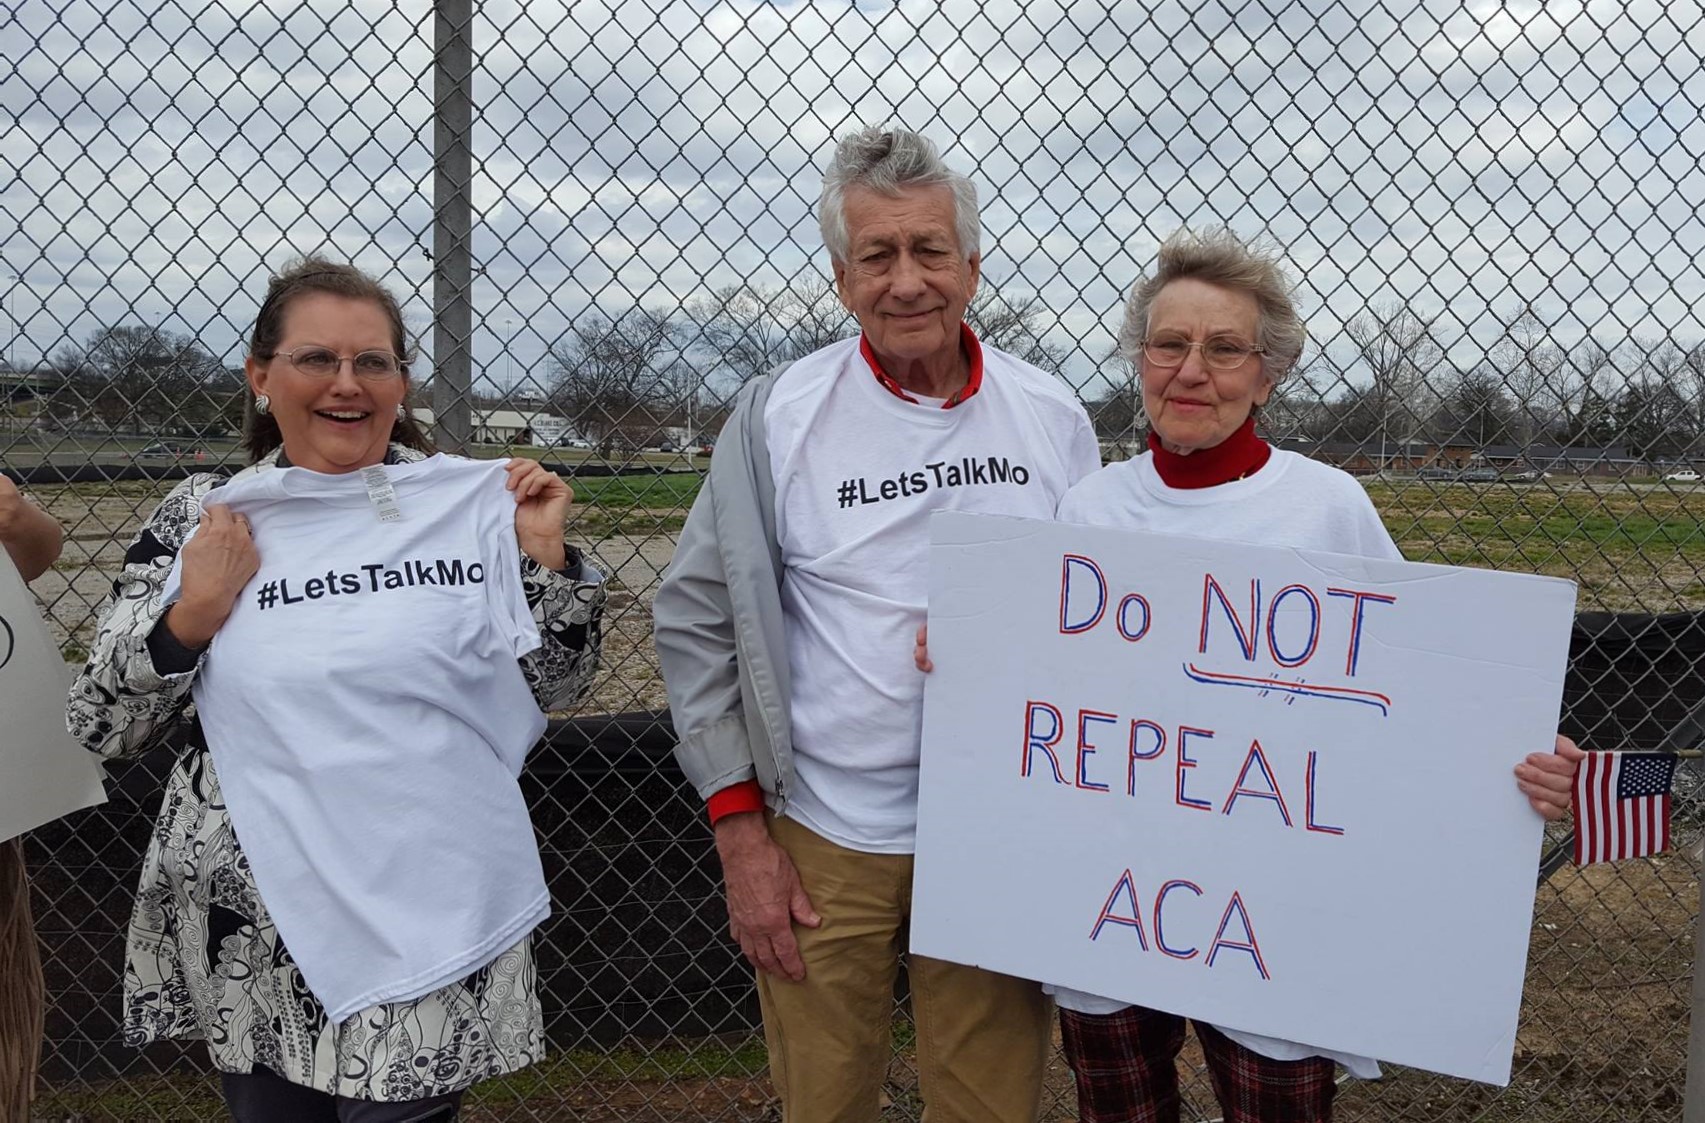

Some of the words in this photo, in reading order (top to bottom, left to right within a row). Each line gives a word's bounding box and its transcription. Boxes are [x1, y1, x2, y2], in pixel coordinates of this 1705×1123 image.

[837, 457, 1029, 509] #LetsTalkMo
[257, 559, 484, 610] #LetsTalkMo
[1059, 554, 1151, 642] Do
[1199, 573, 1397, 677] NOT
[1021, 700, 1344, 835] REPEAL
[1089, 868, 1270, 981] ACA
